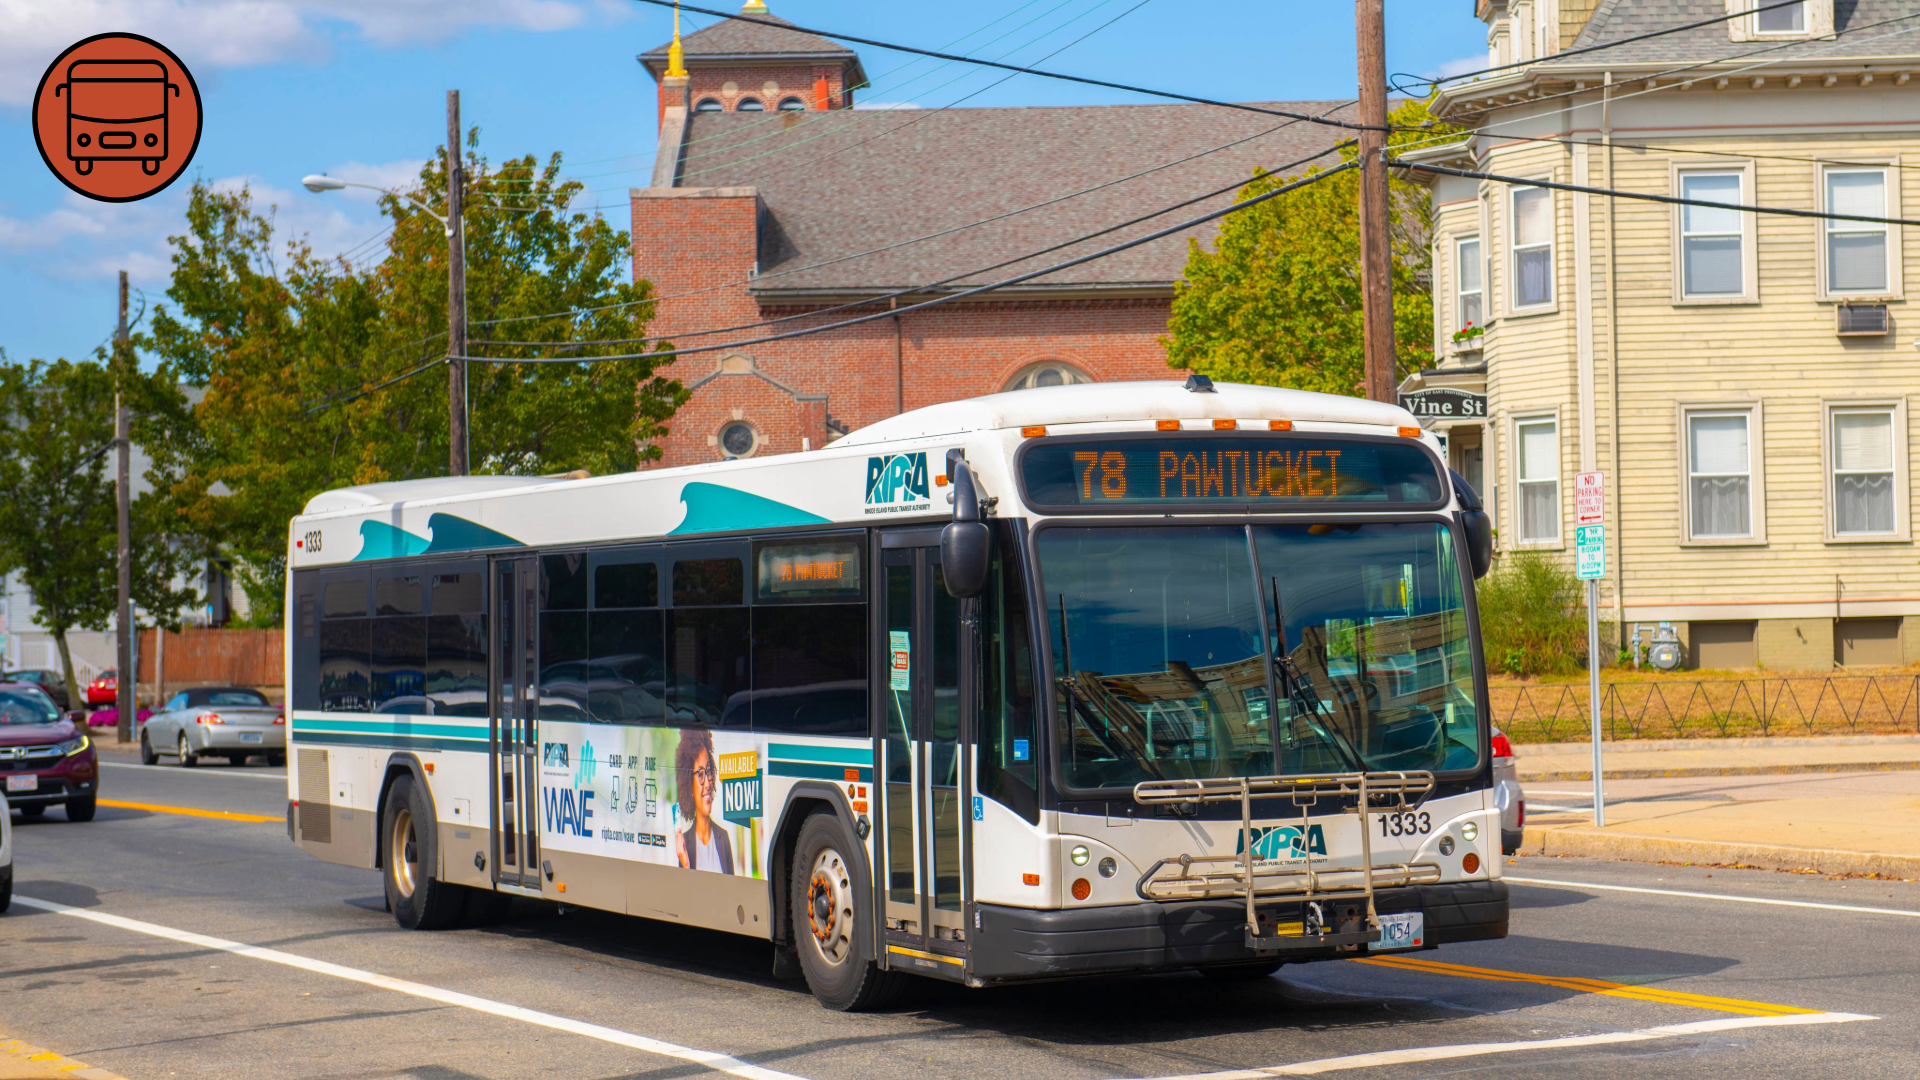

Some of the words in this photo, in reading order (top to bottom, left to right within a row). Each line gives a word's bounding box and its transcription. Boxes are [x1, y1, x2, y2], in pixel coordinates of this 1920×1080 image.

[1444, 390, 1472, 398] PROVIDENCE
[1404, 397, 1453, 415] Vine
[1462, 399, 1483, 415] St
[865, 452, 930, 504] RIPTA
[1074, 451, 1127, 498] 78
[1159, 450, 1341, 498] PAWTUCKET
[1585, 476, 1595, 486] NO
[1578, 486, 1601, 498] PARKING
[1580, 506, 1600, 514] CORNER
[305, 530, 322, 553] 1333
[1578, 530, 1584, 543] 2
[1585, 536, 1602, 544] PARKING
[1581, 545, 1601, 553] 8:00AM
[782, 564, 792, 581] 78
[796, 561, 843, 580] PAWTUCKET
[609, 754, 622, 768] CARD
[628, 756, 638, 770] APP
[645, 757, 656, 772] RIDE
[720, 755, 754, 775] AVAILABLE
[725, 780, 760, 812] NOW!
[544, 786, 595, 838] WAVE
[1378, 812, 1431, 837] 1333
[602, 826, 635, 843] ripta.com/wave
[1236, 824, 1327, 860] RIPTA
[1383, 922, 1410, 940] 1054
